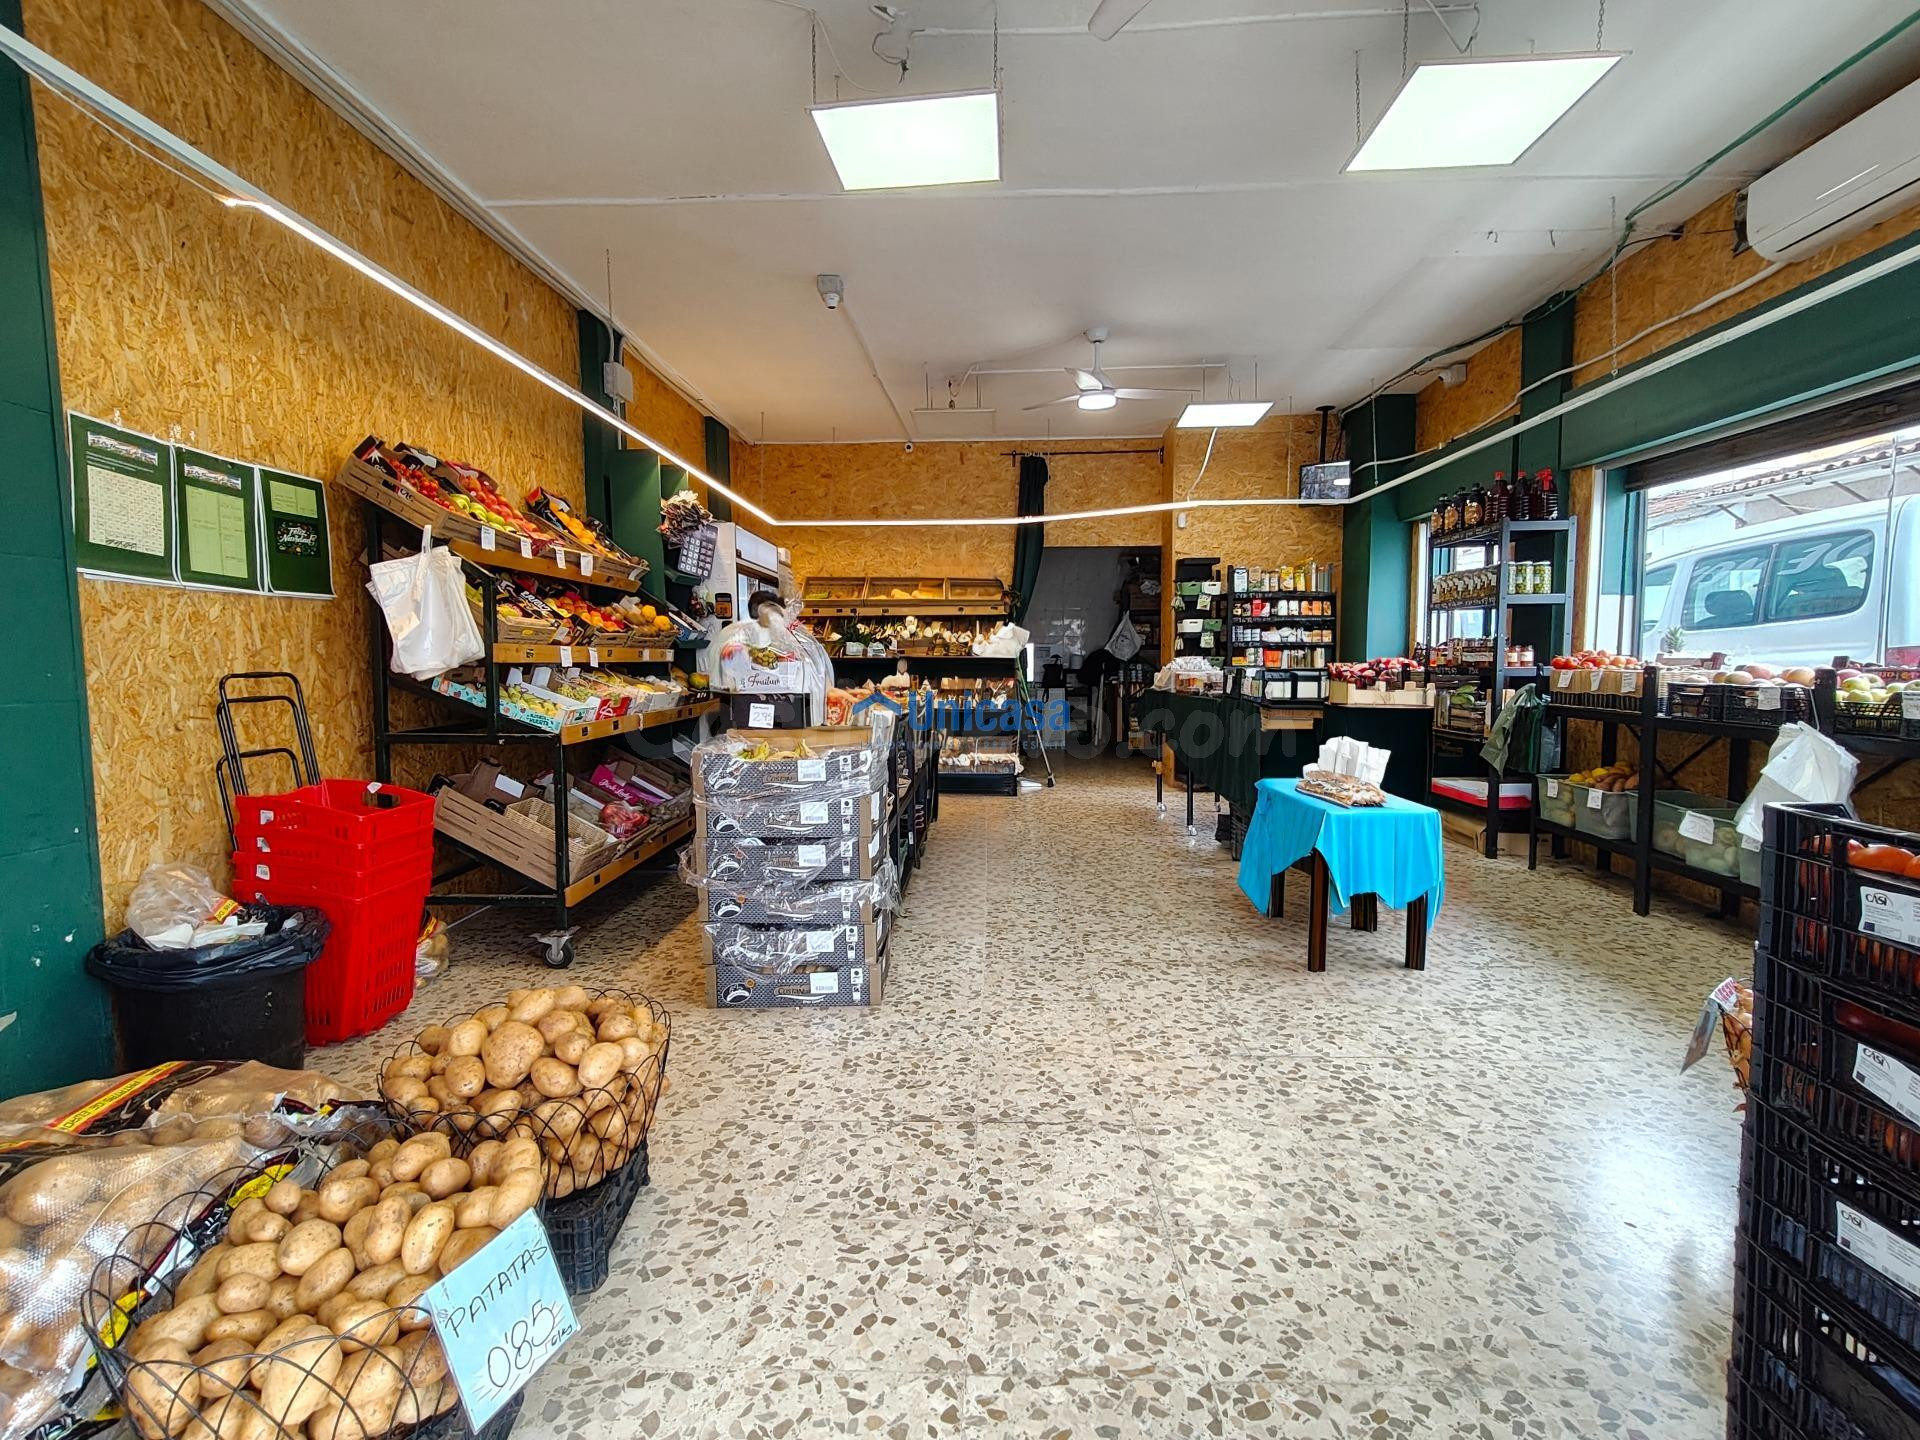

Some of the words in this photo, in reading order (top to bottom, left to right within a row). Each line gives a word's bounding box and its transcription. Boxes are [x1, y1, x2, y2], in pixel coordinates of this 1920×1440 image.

[1865, 893, 1888, 907] CASI
[1862, 1047, 1885, 1068] CASI
[1840, 1209, 1863, 1229] CASI
[444, 1242, 548, 1339] PATATAS
[487, 1298, 556, 1388] 0'85
